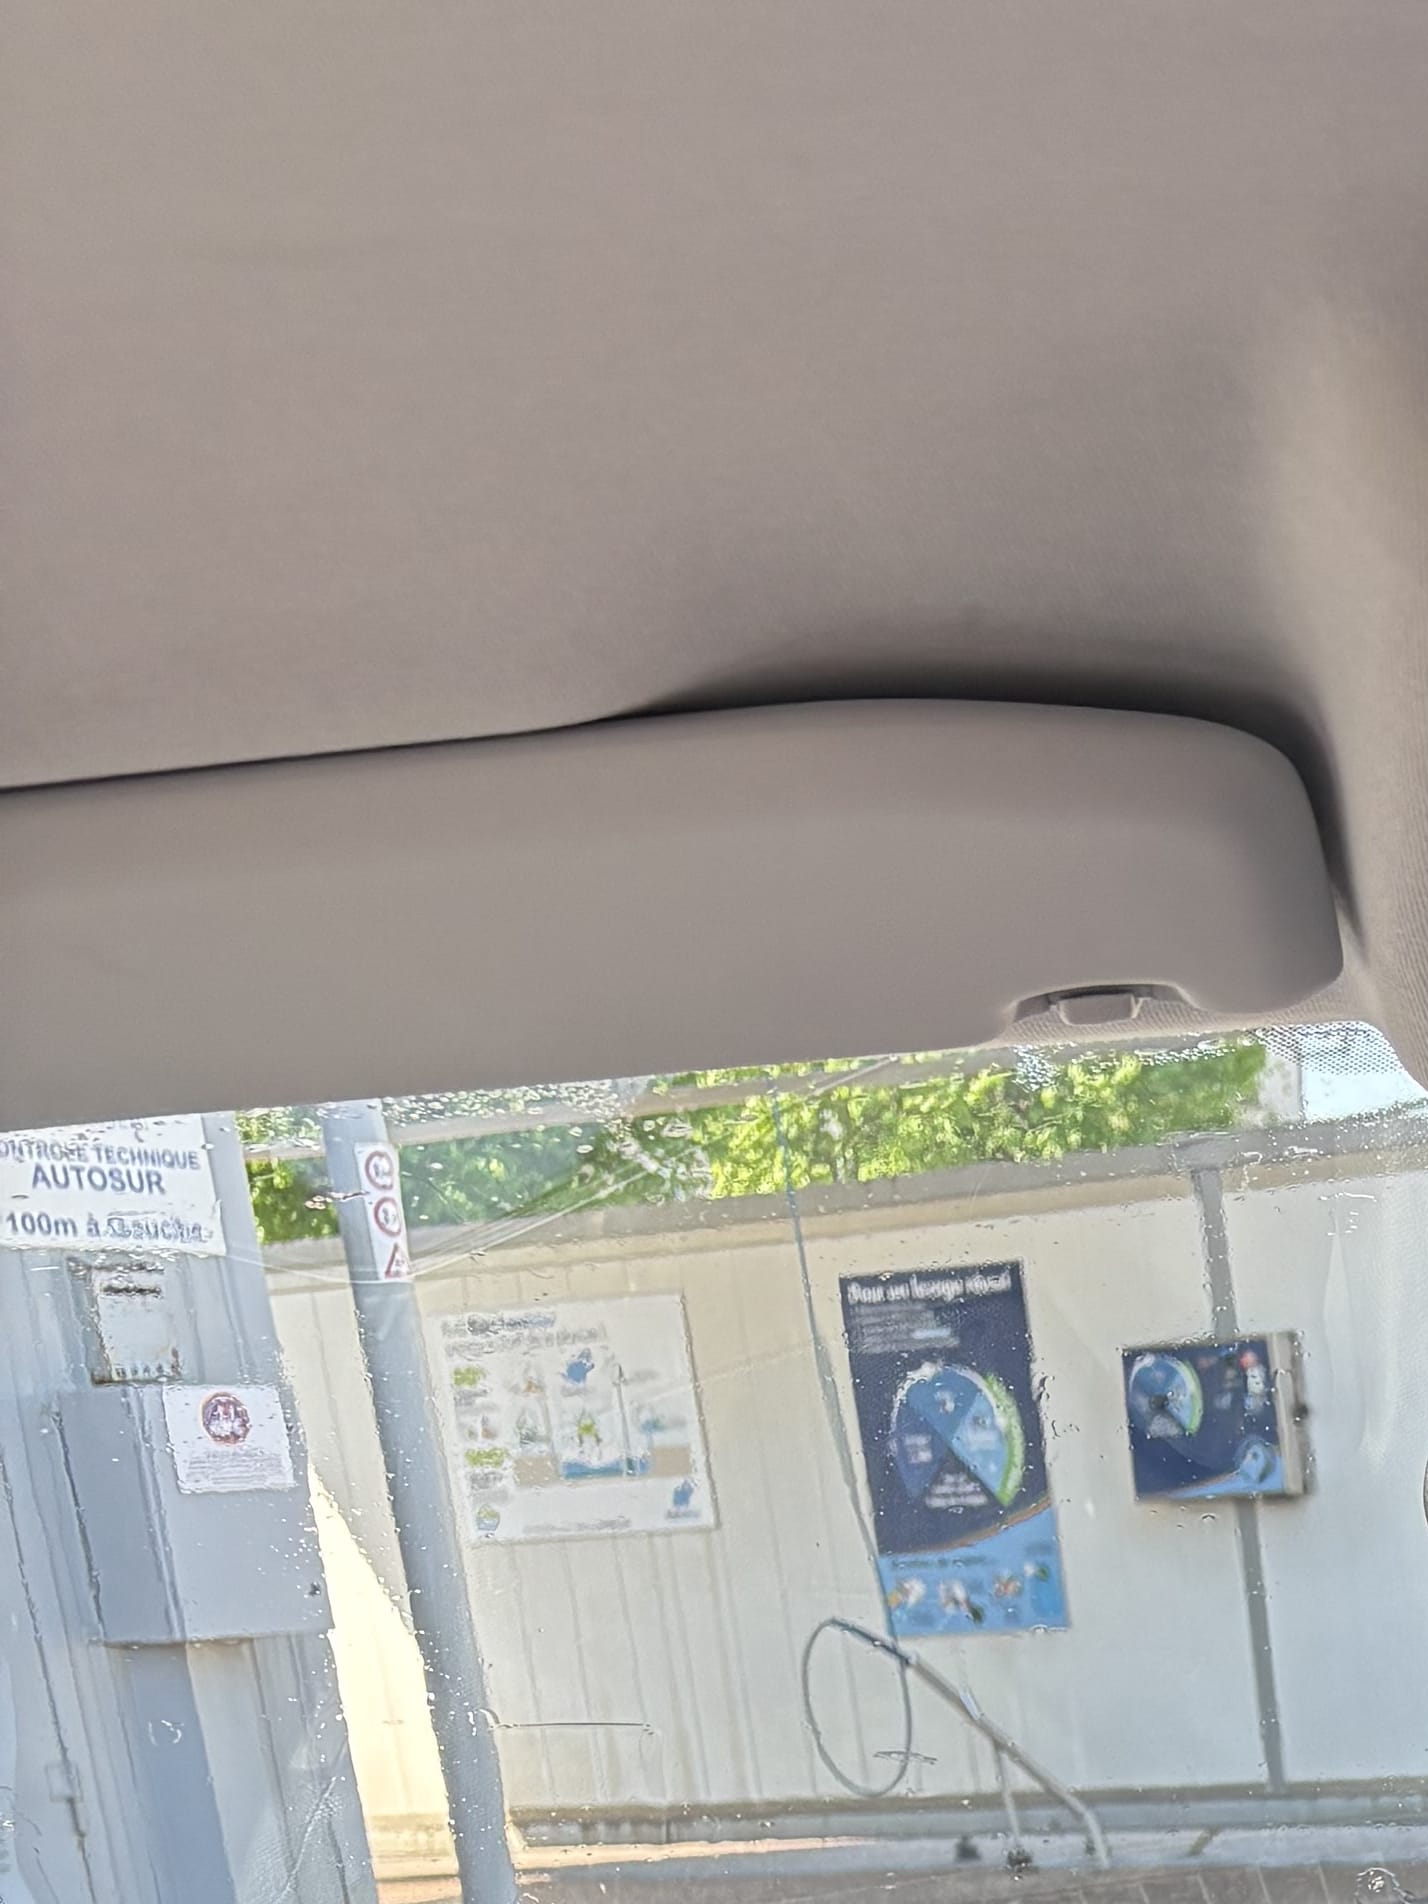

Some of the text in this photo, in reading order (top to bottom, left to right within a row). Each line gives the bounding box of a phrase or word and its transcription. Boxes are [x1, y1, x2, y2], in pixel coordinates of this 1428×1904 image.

[0, 1138, 201, 1170] ONTROLE TECHNIQUE
[32, 1163, 166, 1195] AUTOSUR
[5, 1210, 78, 1237] 100m
